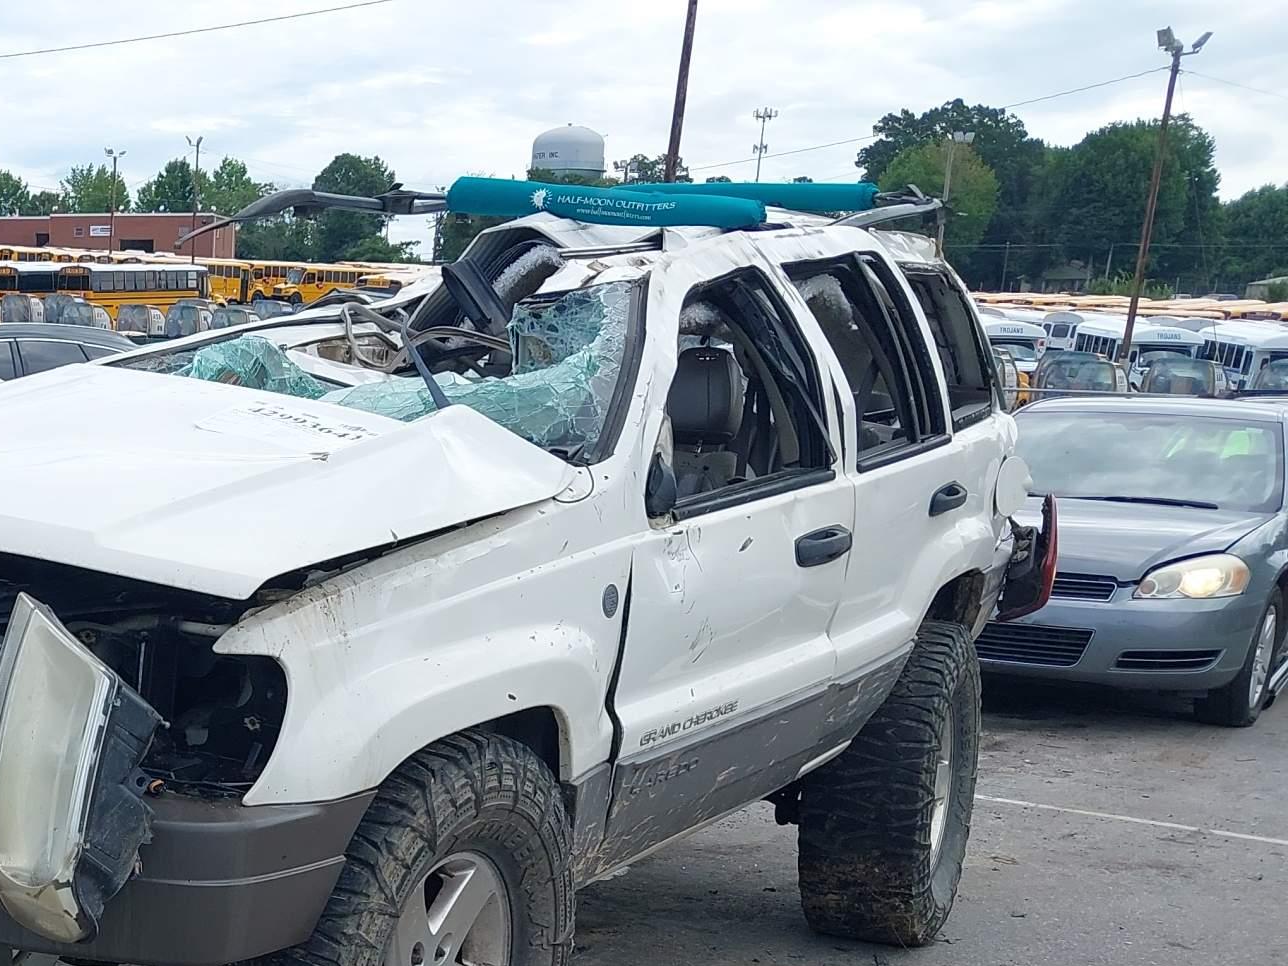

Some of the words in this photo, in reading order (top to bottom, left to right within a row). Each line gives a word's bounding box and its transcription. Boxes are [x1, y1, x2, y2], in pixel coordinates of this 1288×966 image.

[557, 195, 614, 207] HALF-MOON
[615, 201, 677, 211] OUTFITTERS
[639, 722, 681, 747] GRAND
[682, 700, 739, 731] CHEROKEE
